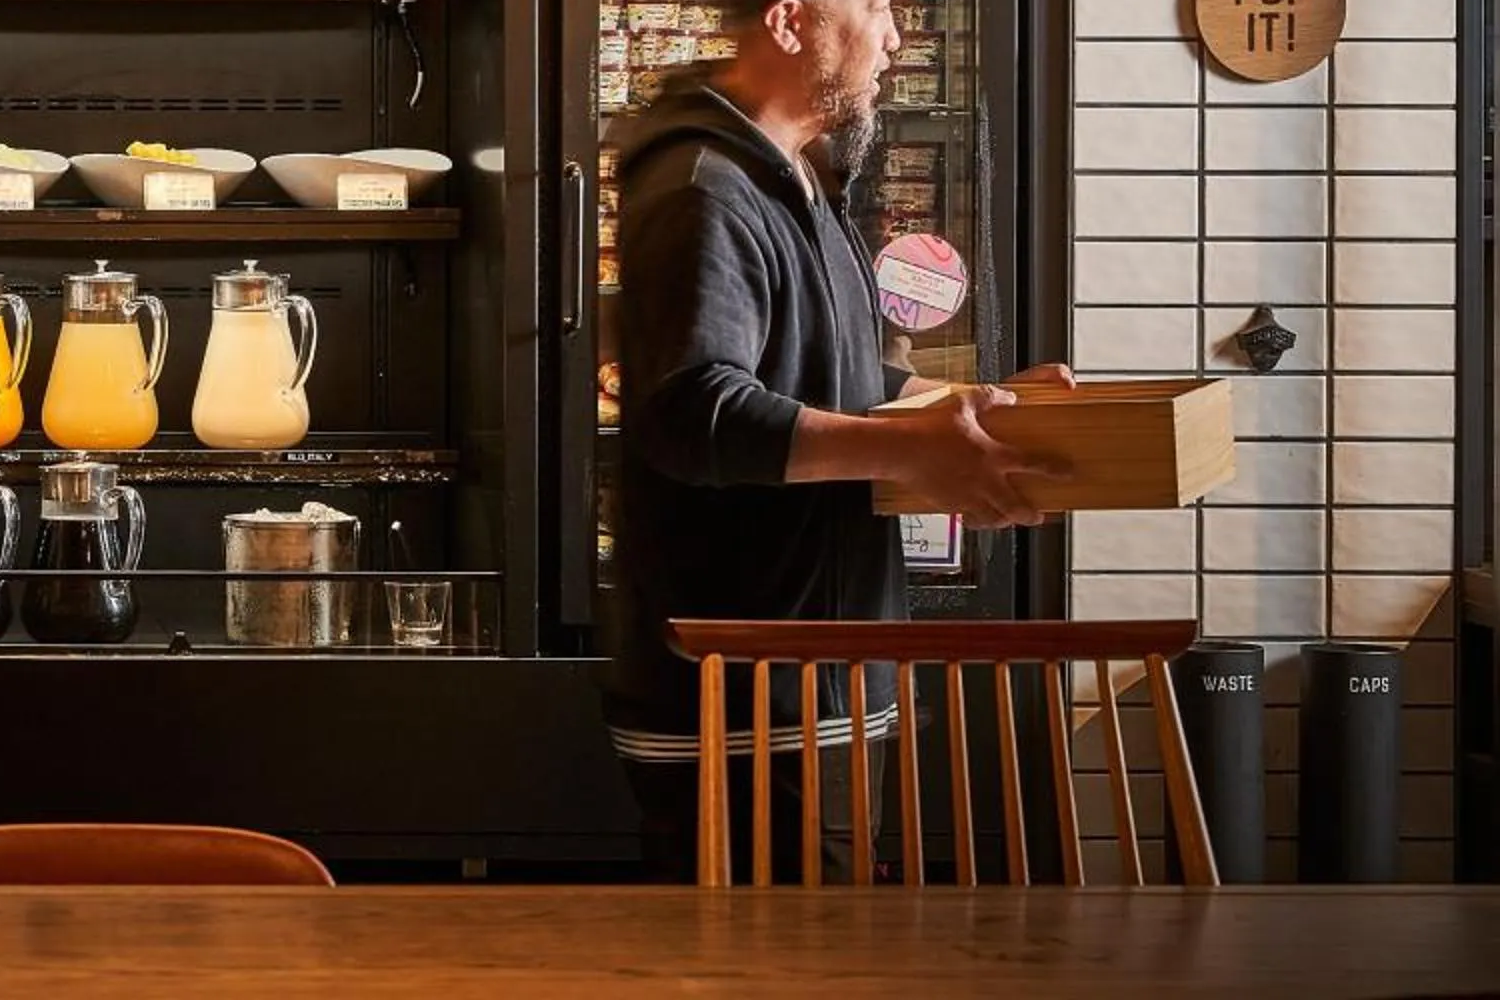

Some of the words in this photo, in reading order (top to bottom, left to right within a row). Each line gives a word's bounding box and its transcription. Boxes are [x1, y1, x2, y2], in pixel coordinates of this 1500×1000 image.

[1247, 12, 1295, 53] IT!
[1202, 674, 1254, 692] WASTE
[1349, 676, 1390, 694] CAPS
